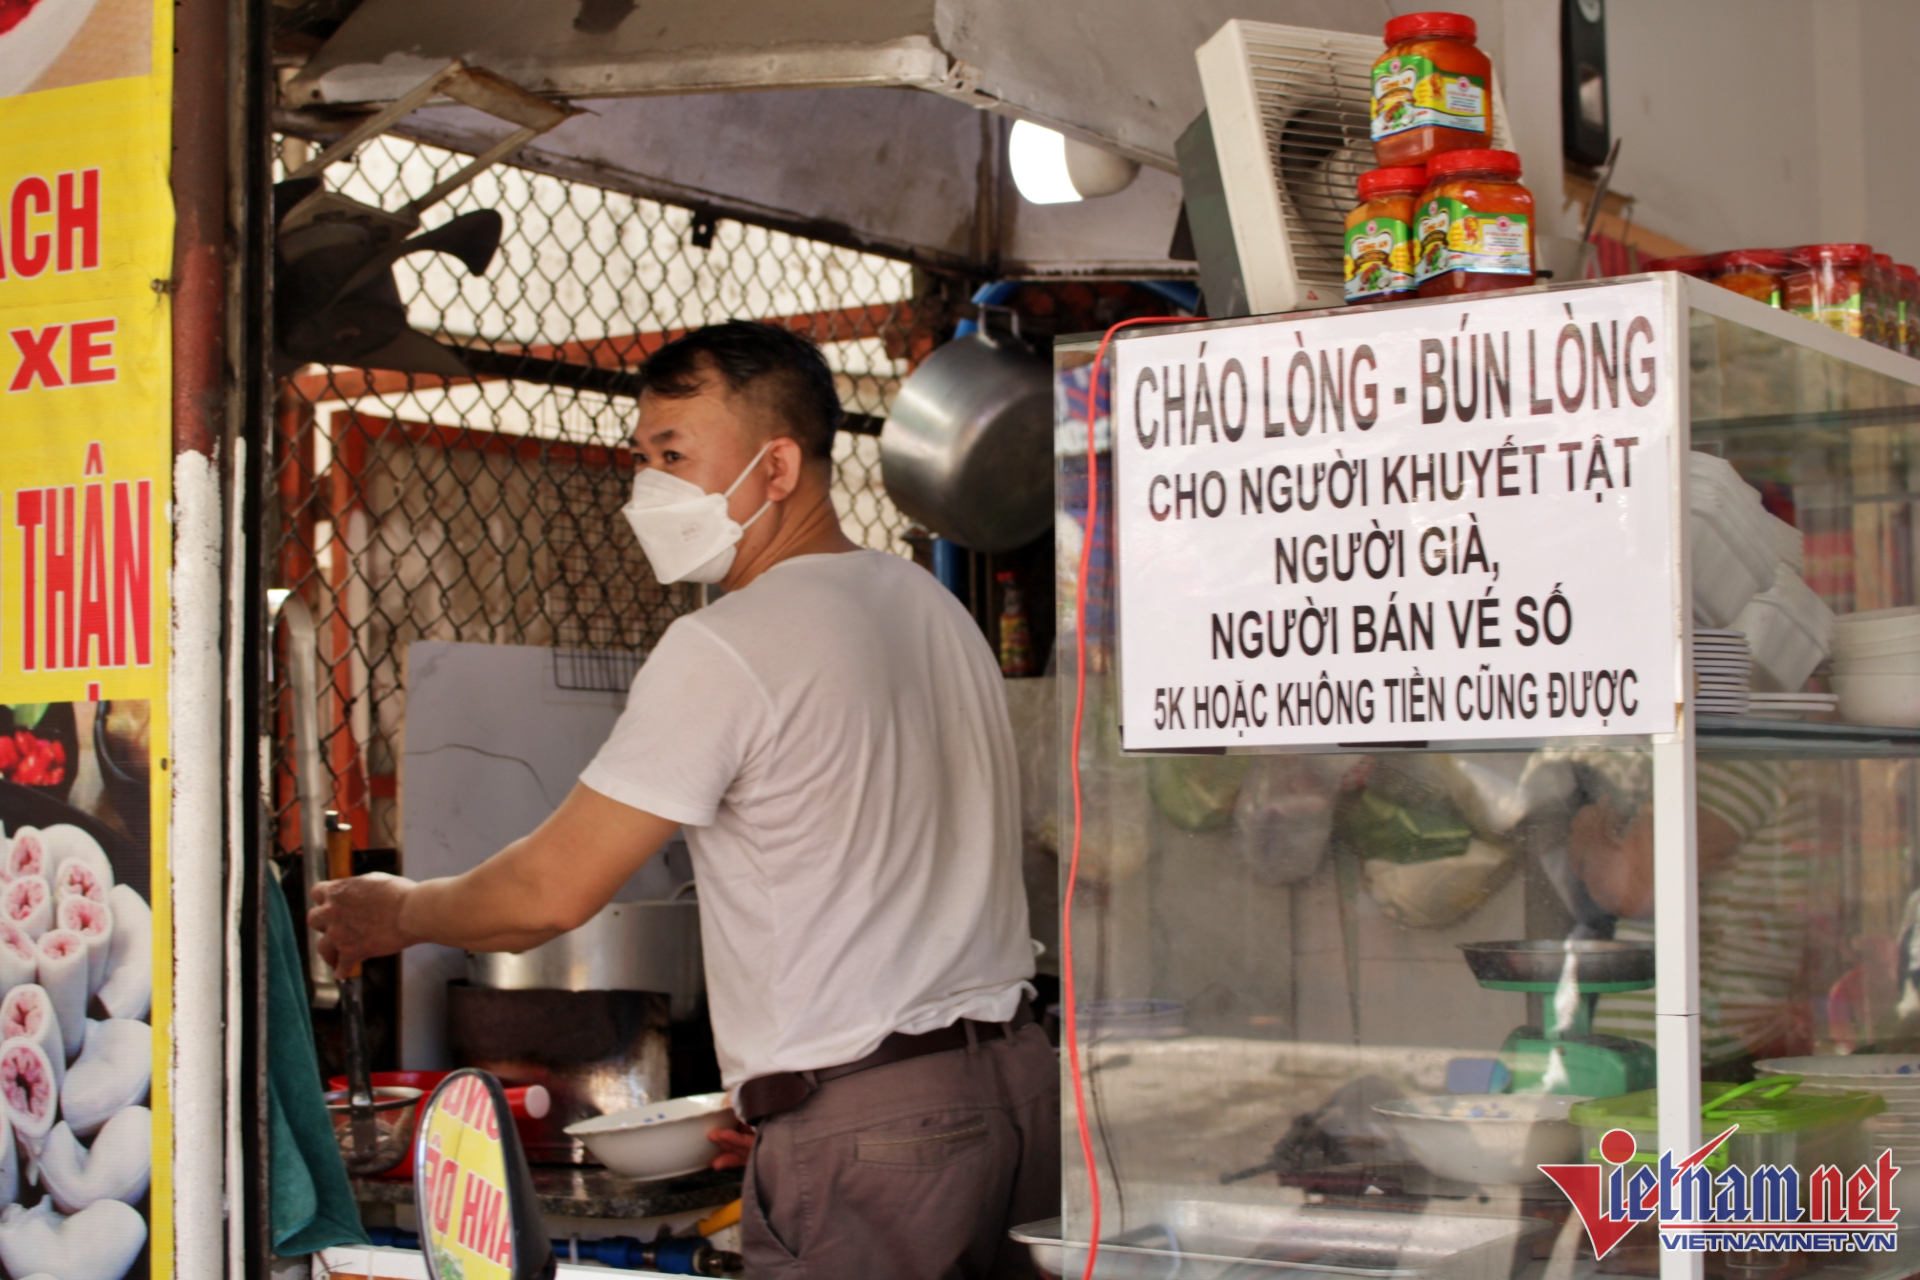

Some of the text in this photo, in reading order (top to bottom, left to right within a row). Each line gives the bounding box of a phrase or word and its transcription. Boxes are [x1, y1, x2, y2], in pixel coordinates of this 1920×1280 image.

[0, 167, 101, 281] CH
[7, 316, 118, 393] XE
[1135, 341, 1248, 450] CHÁO
[1263, 331, 1379, 440] LÒNG
[1421, 313, 1511, 426] BÚN
[1529, 302, 1657, 416] LÒNG
[1149, 433, 1641, 522] CHO NGƯỜI KHUYẾT TẬT
[15, 439, 153, 701] THẬN
[1275, 511, 1500, 585] NGƯỜI GIÀ,
[1211, 580, 1573, 661] NGƯỜI BÁN VÉ SỐ
[1154, 663, 1640, 737] 5K HOẶC KHÔNG TIỀN CŨNG ĐƯỢC
